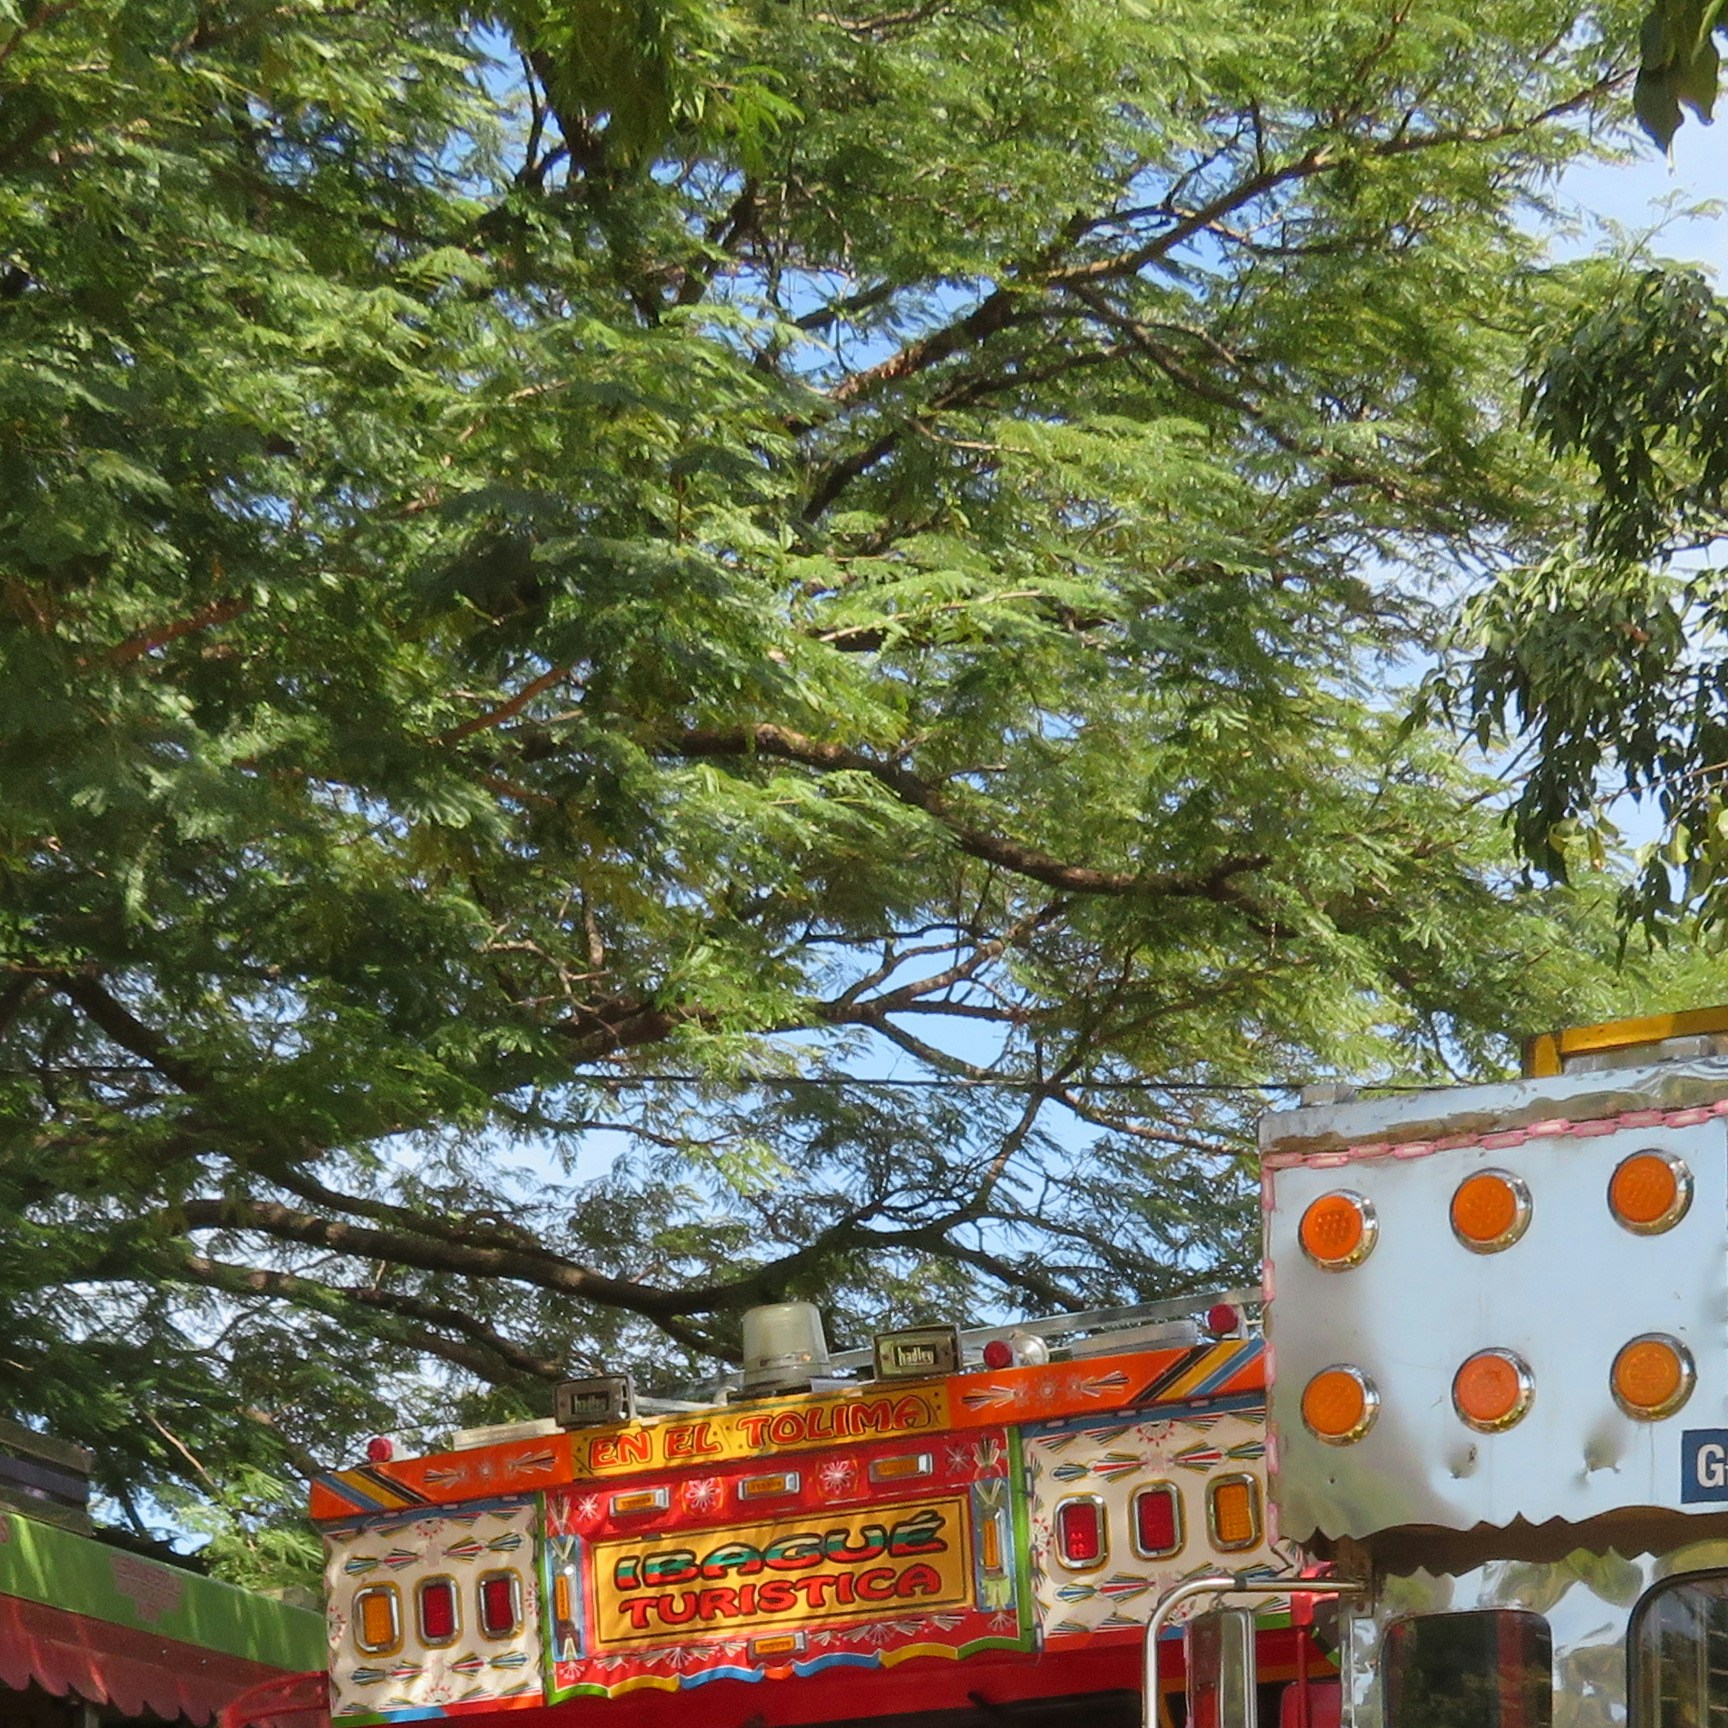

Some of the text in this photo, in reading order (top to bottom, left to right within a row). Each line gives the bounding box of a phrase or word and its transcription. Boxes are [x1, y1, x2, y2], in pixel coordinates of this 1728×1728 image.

[589, 1395, 932, 1470] EN EL TOLIMA
[614, 1509, 948, 1590] IBAGUÉ
[618, 1562, 944, 1629] TURISTICA
